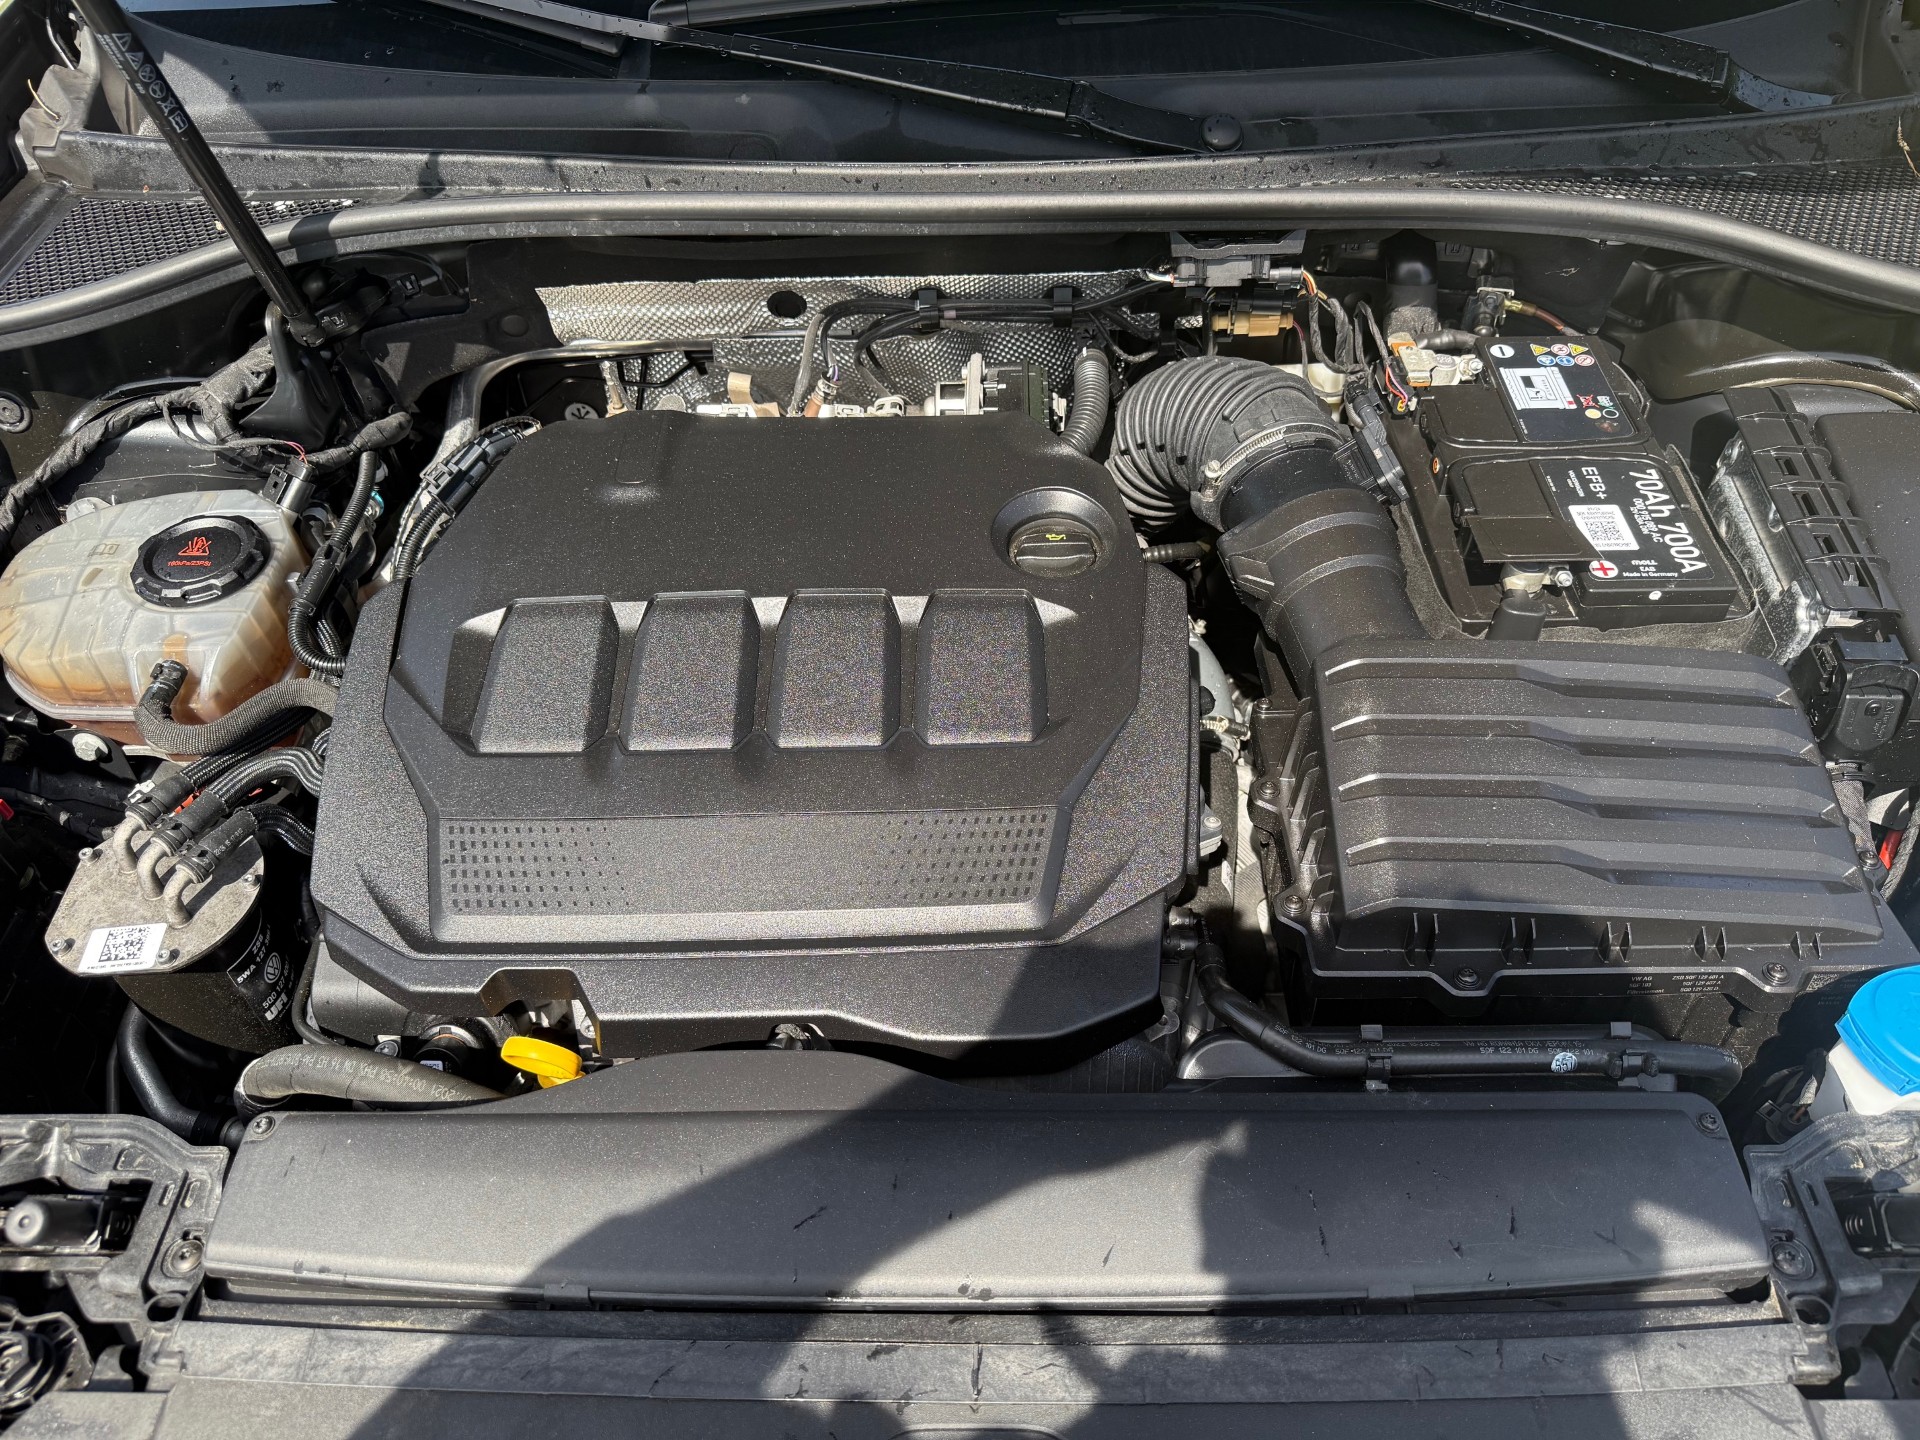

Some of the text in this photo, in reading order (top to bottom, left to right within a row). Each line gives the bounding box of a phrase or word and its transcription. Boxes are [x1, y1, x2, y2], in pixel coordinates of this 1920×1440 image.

[1581, 466, 1608, 500] EFB+
[1629, 468, 1708, 574] 70Ah 700A
[1638, 510, 1652, 521] 915
[1650, 532, 1664, 543] AC
[236, 964, 257, 984] 5WA
[275, 975, 286, 992] 127
[264, 992, 288, 1021] UFI
